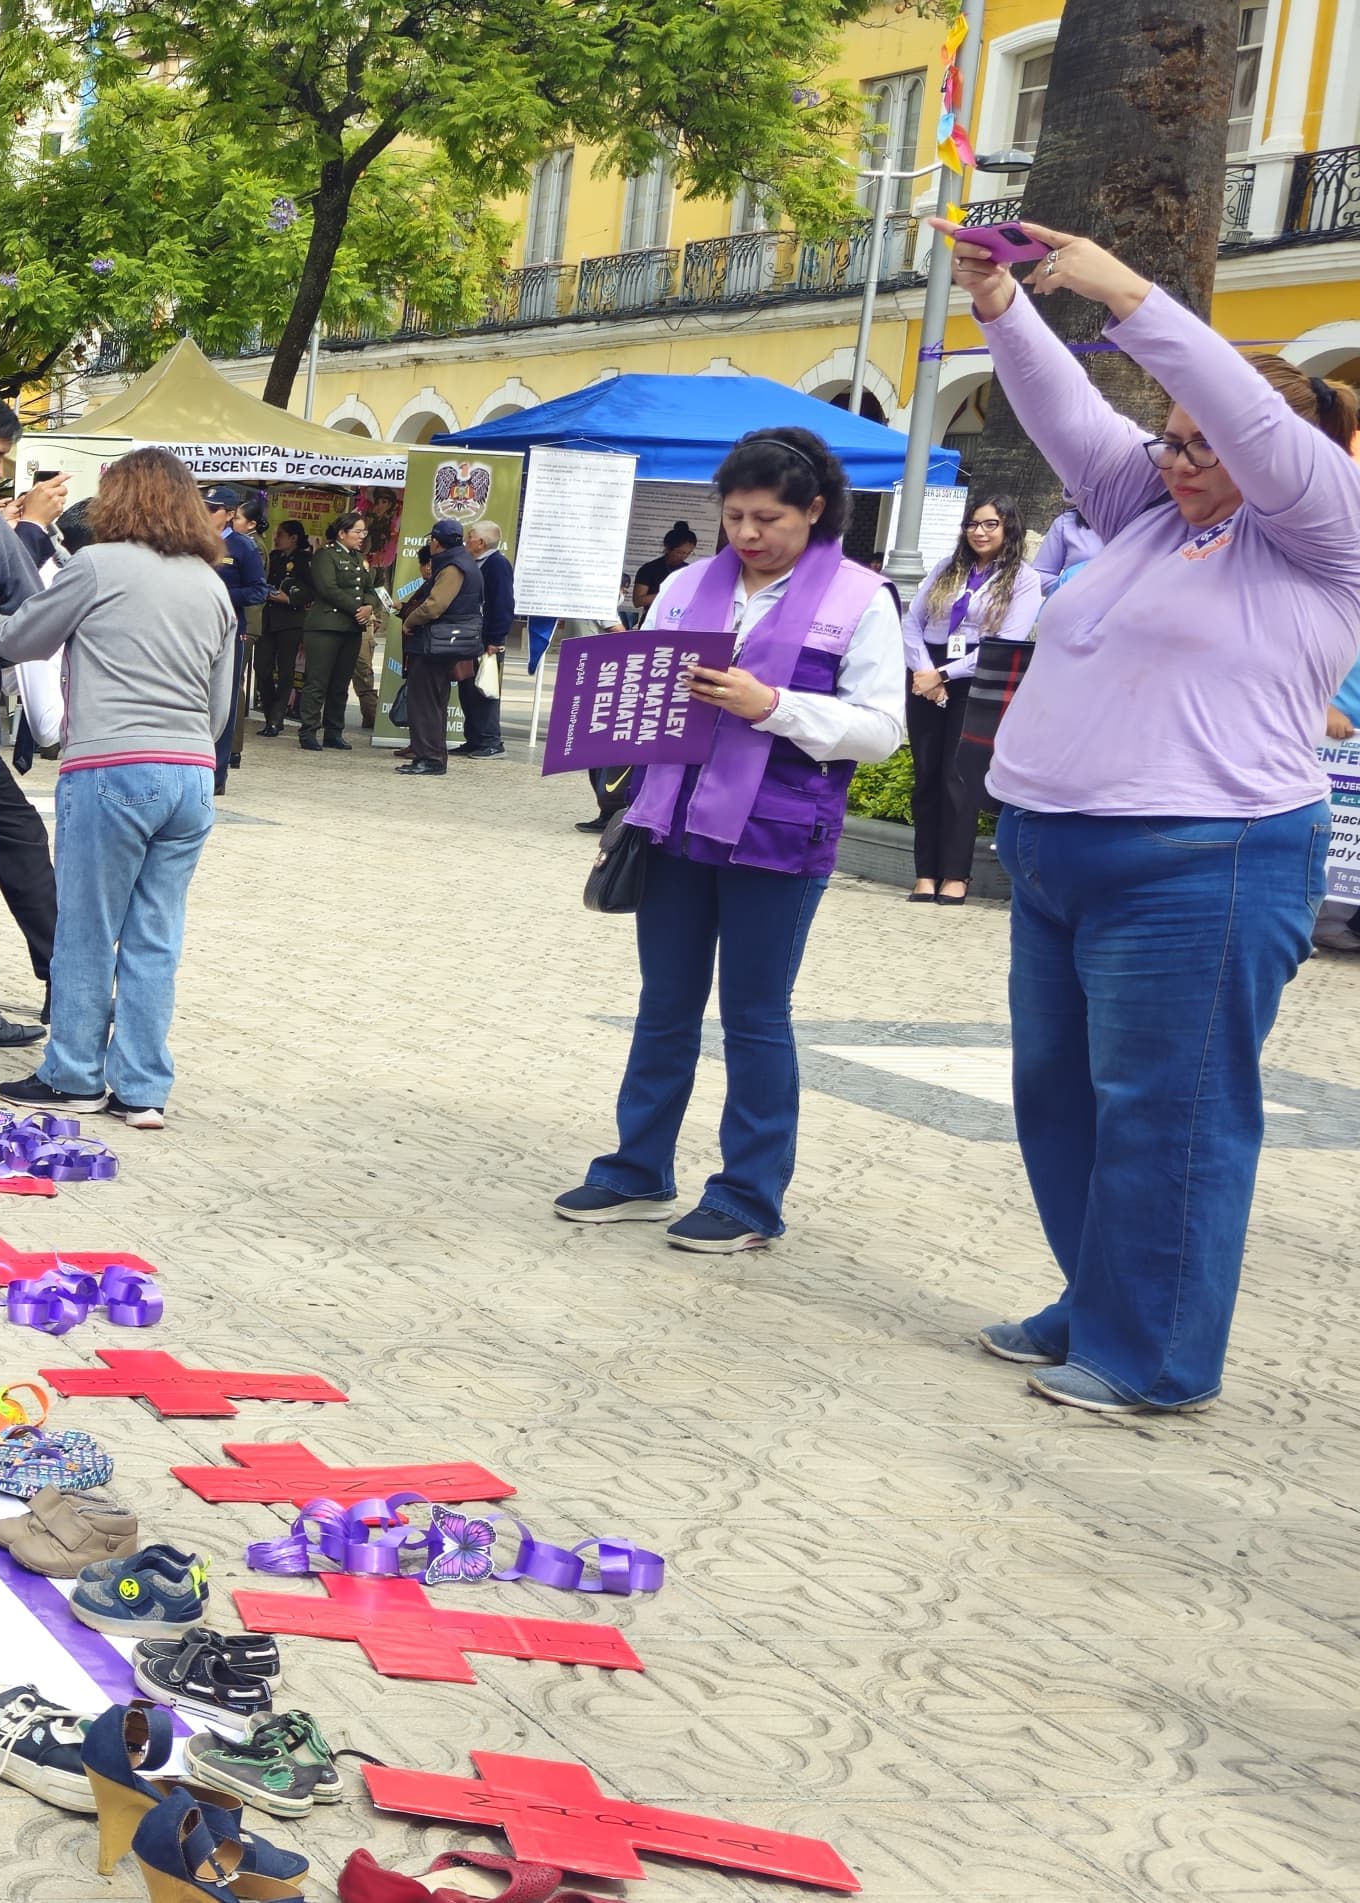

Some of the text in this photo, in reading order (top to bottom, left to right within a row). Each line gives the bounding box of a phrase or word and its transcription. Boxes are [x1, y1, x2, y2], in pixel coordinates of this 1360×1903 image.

[184, 461, 406, 481] OLESCENTES DE COCHABAMB
[208, 445, 289, 458] MUNICIPAL
[575, 653, 588, 685] #Ley348
[588, 662, 618, 734] SIN ELLA
[612, 654, 646, 741] IMAGÍNATE
[635, 647, 674, 745] NOS MATAN,
[664, 708, 688, 738] LEY
[463, 1791, 775, 1856] MARIA
